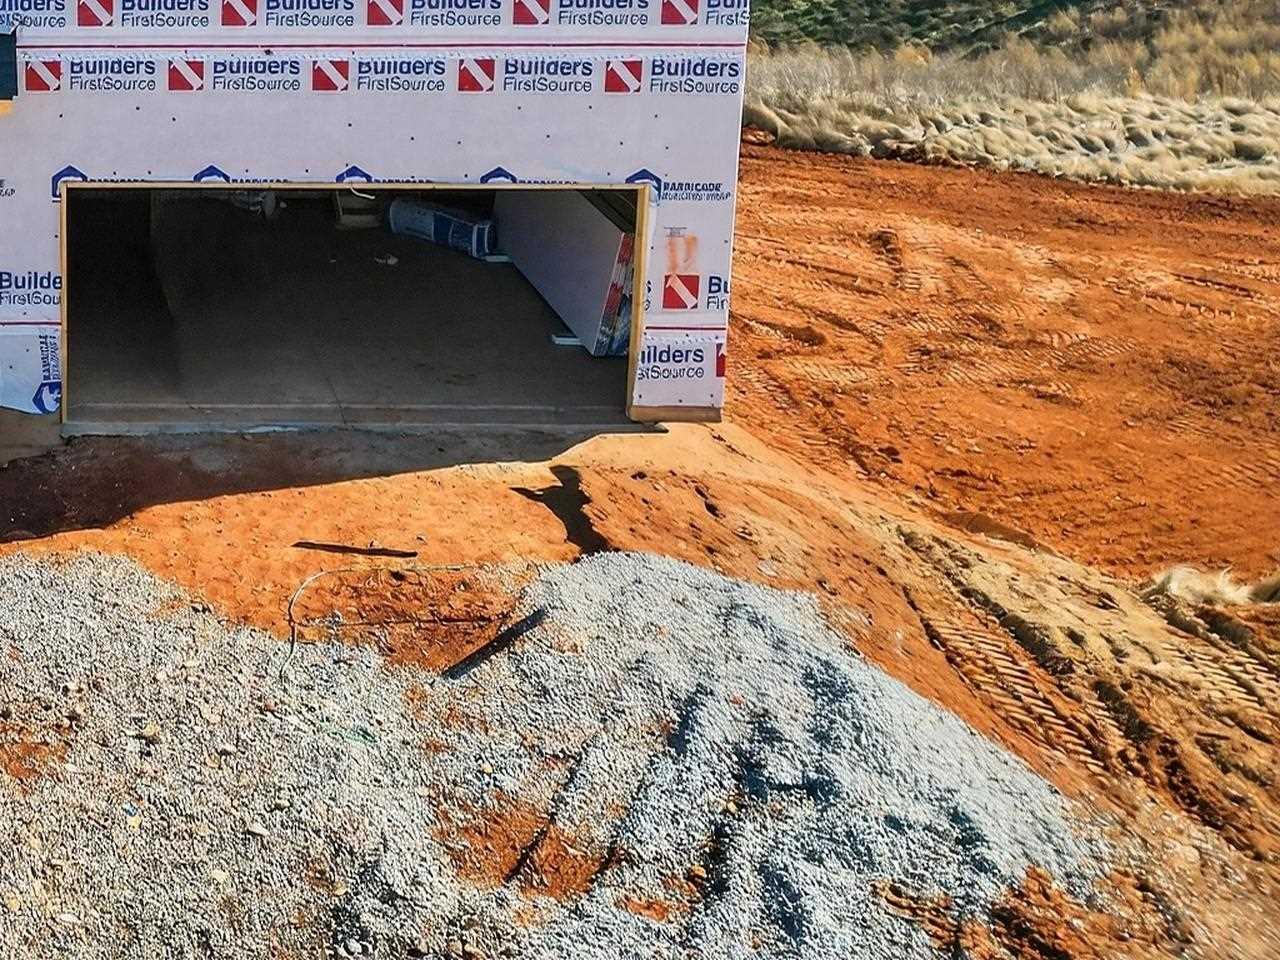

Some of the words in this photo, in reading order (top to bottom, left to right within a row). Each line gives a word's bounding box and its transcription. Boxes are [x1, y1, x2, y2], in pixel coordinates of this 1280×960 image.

[122, 12, 209, 28] FirstSource
[266, 12, 354, 28] FirstSource
[411, 11, 501, 27] FirstSource
[558, 10, 648, 26] FirstSource
[70, 60, 156, 76] Builders
[504, 60, 593, 77] Builders
[651, 60, 740, 78] Builders
[70, 75, 156, 90] FirstSource
[212, 75, 300, 91] FirstSource
[357, 76, 445, 91] FirstSource
[503, 77, 592, 93] FirstSource
[650, 78, 739, 94] FirstSource
[0, 271, 62, 291] Builde
